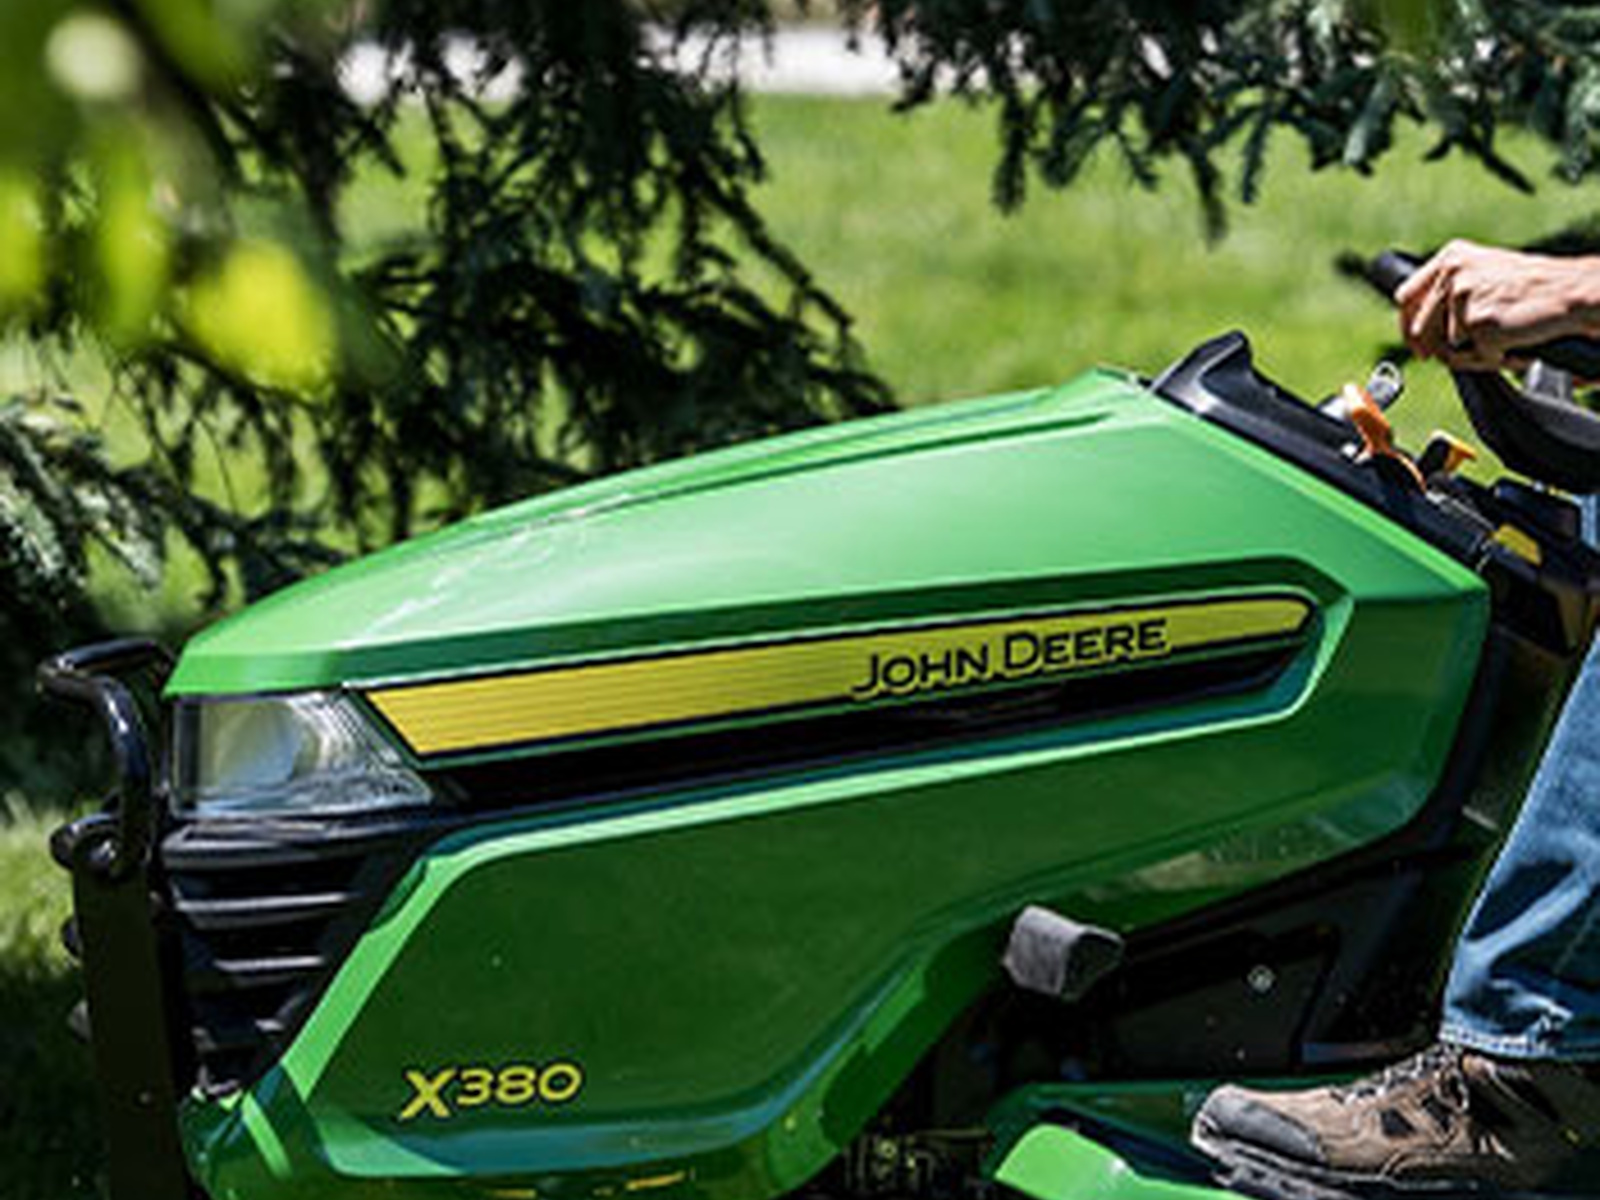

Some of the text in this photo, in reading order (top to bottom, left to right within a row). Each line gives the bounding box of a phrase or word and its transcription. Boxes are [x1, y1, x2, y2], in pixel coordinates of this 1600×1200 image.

[851, 617, 1168, 694] JOHN DEERE
[400, 1062, 583, 1119] X380
